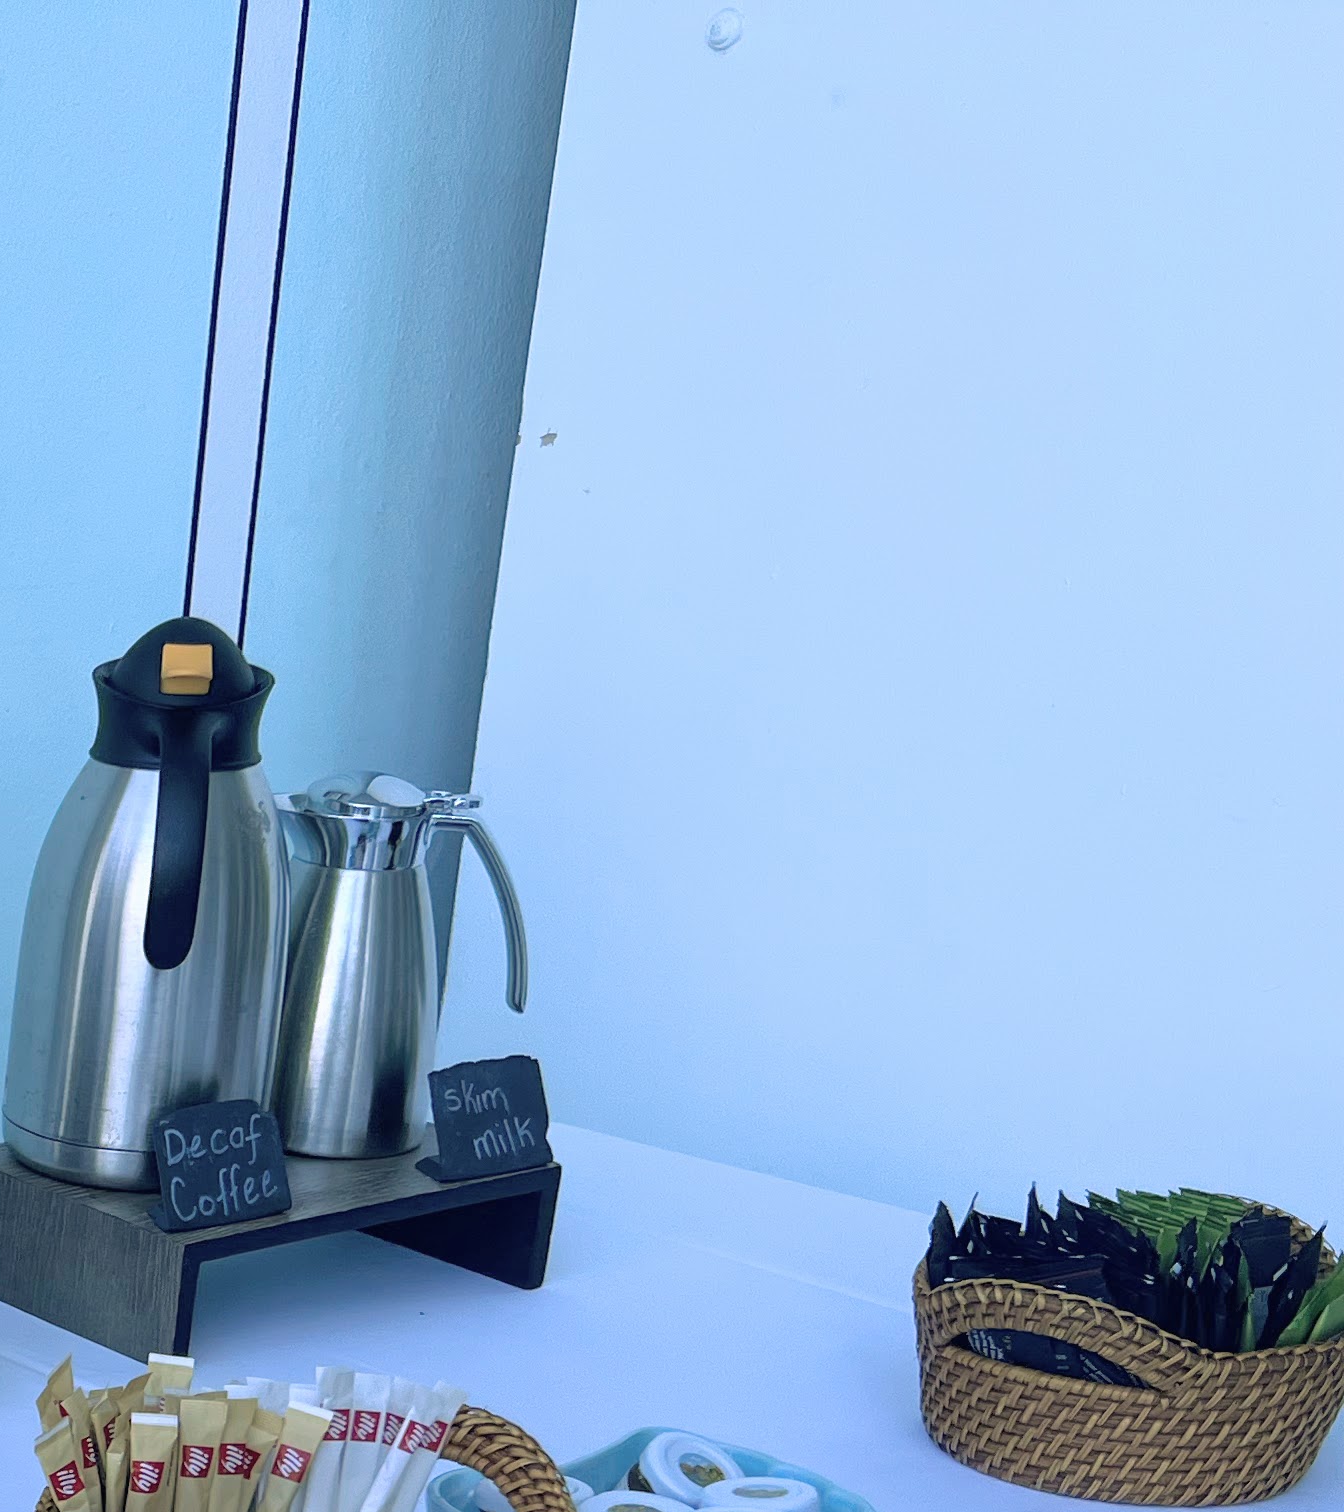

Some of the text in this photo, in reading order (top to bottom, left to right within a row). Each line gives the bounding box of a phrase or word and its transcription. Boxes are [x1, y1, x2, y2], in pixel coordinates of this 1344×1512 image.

[163, 1113, 262, 1167] Decaf
[472, 1116, 536, 1161] milk
[170, 1163, 279, 1223] Coffee
[183, 1446, 210, 1477] illy
[276, 1447, 305, 1478] illy
[55, 1468, 78, 1496] illy
[131, 1462, 160, 1493] illy
